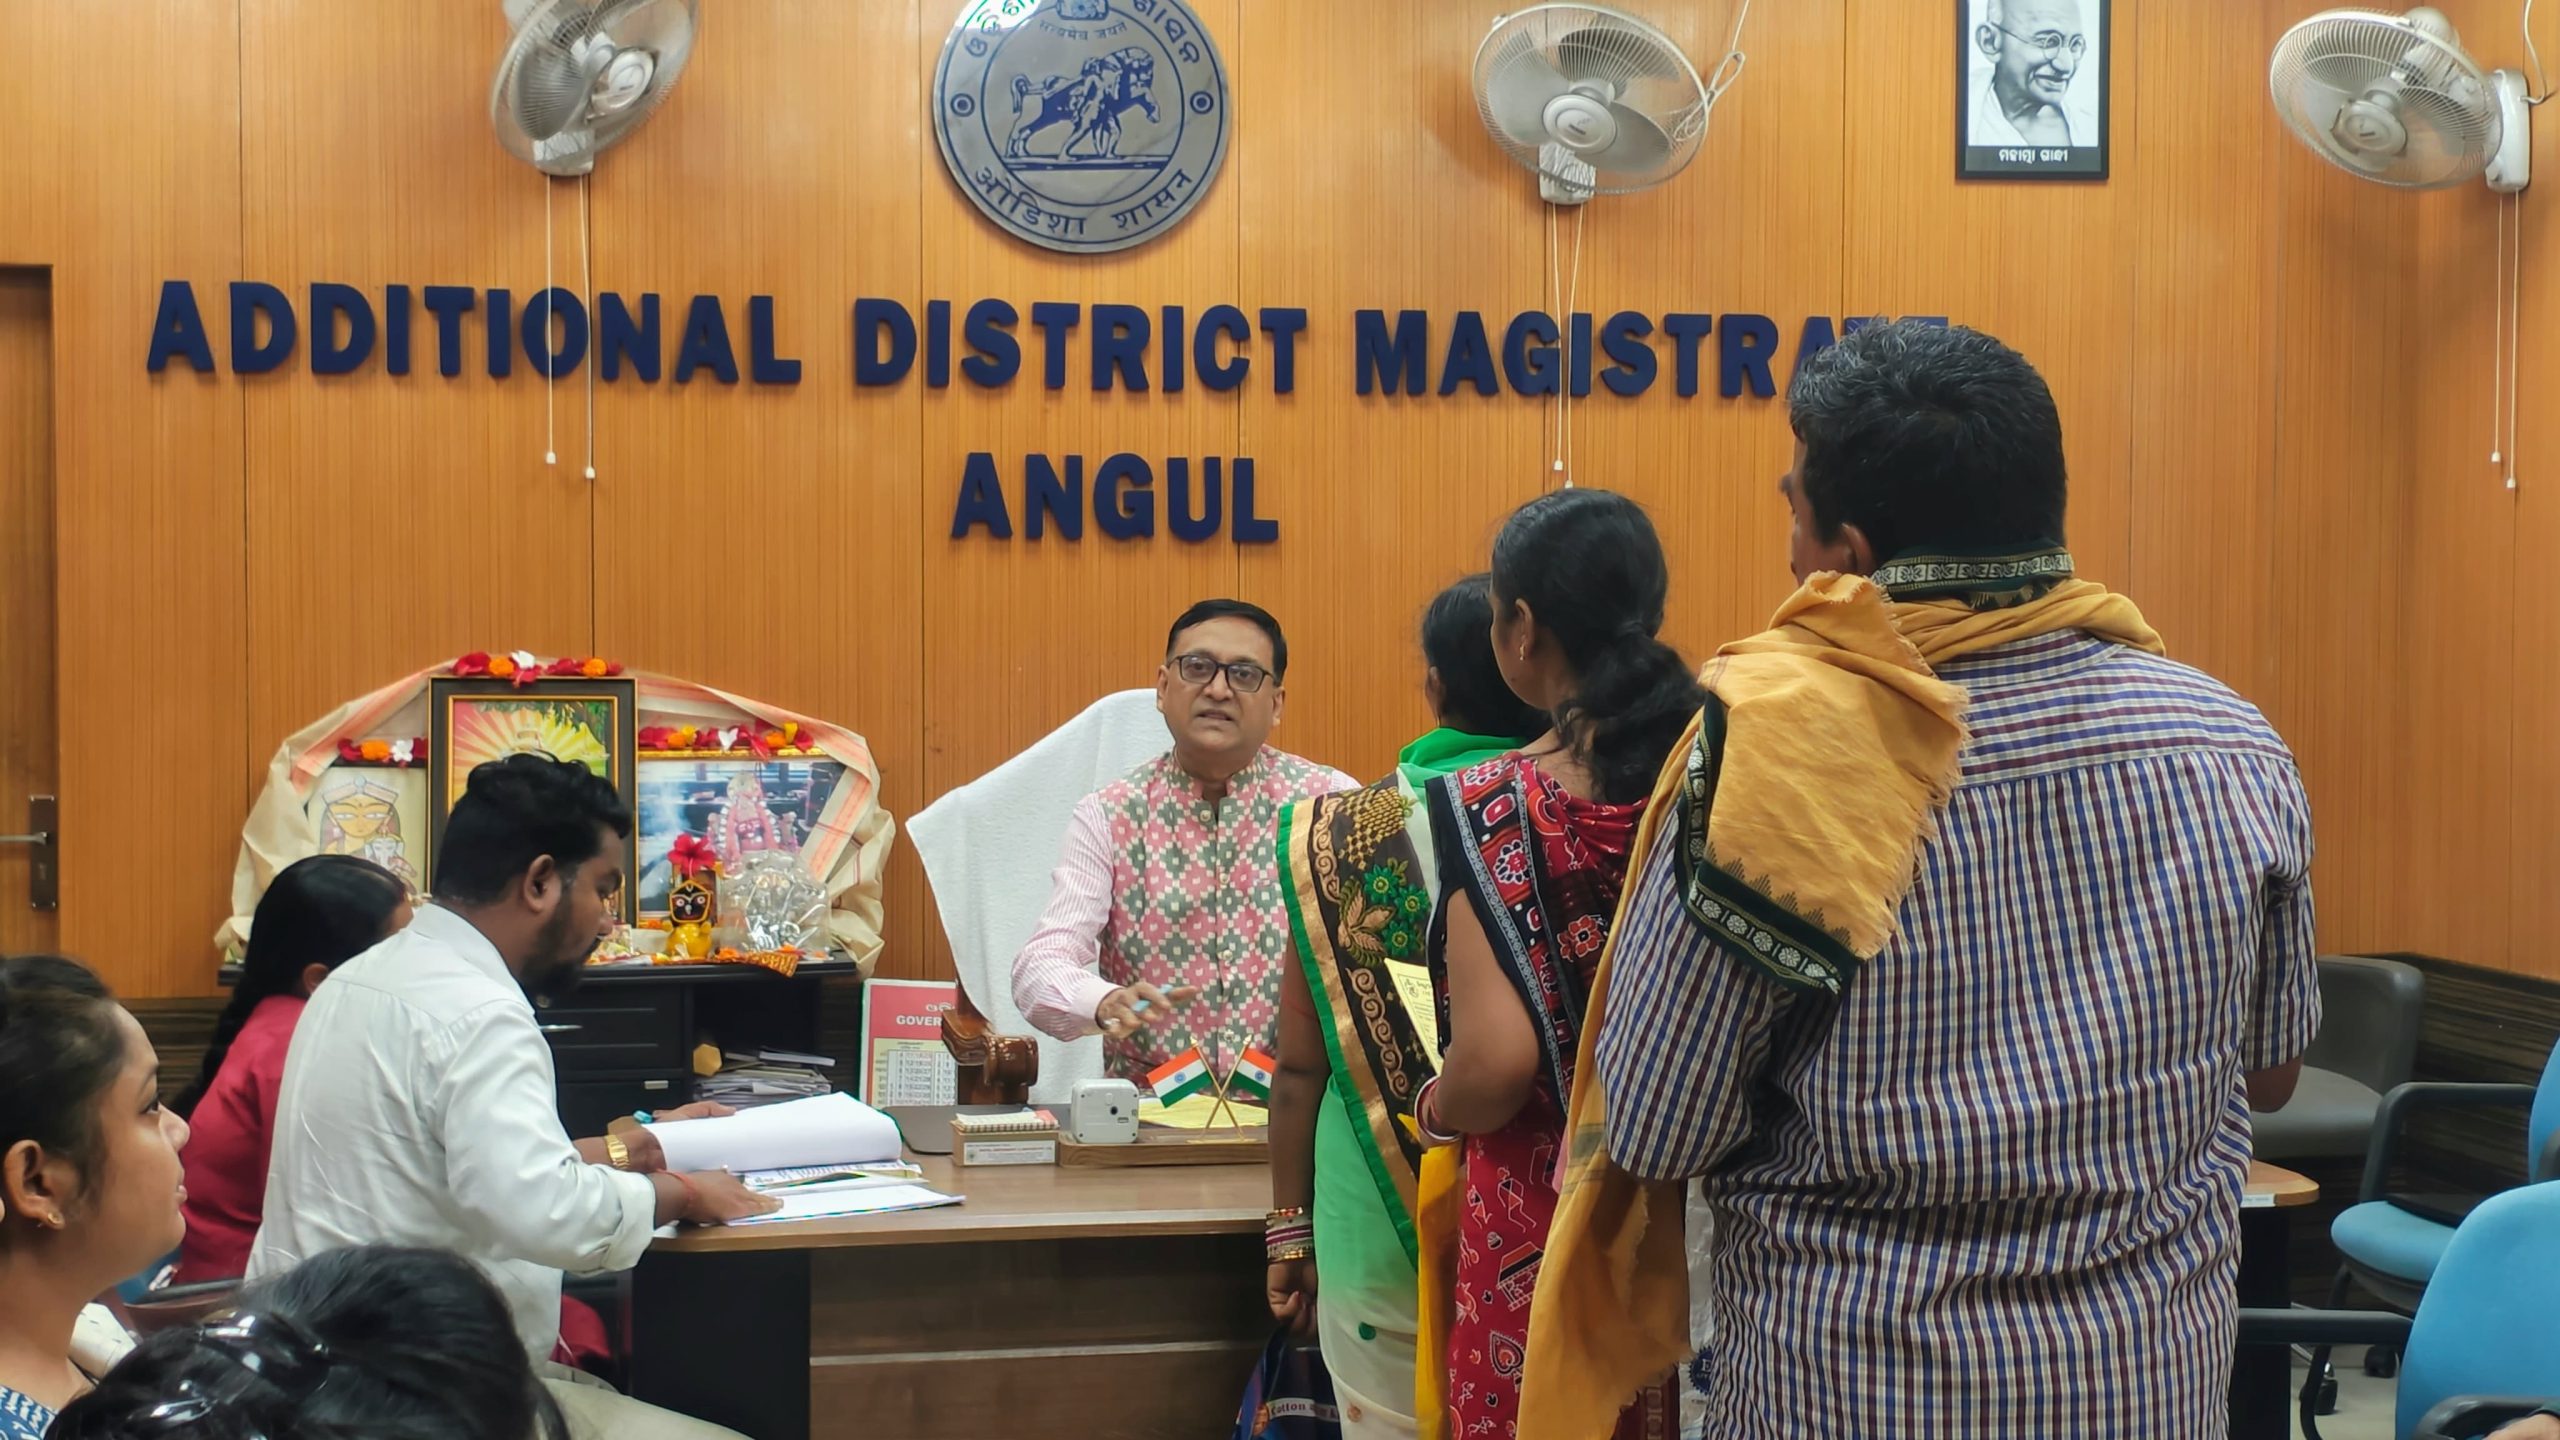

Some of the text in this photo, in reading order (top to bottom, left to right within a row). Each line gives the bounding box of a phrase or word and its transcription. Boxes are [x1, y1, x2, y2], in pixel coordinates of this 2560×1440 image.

[1110, 168, 1193, 231] शासन
[148, 281, 1949, 397] ADDITIONAL DISTRICT MAGISTRA
[952, 453, 1277, 544] ANGUL
